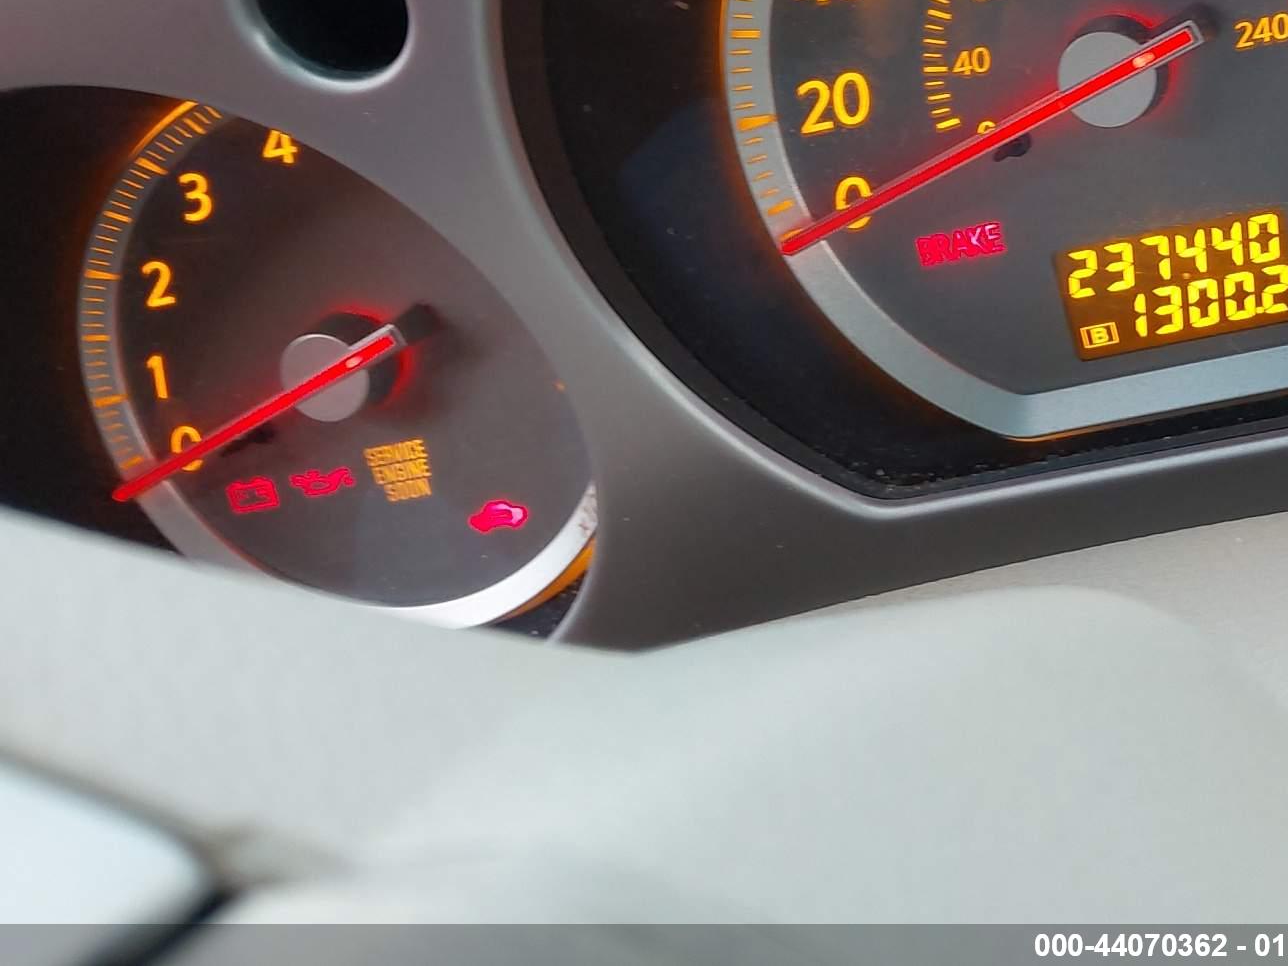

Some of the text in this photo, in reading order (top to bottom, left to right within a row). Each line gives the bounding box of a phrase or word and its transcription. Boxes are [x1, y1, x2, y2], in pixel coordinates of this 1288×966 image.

[953, 46, 991, 77] 40
[796, 71, 871, 135] 20
[262, 129, 299, 164] 4
[178, 172, 213, 222] 3
[835, 176, 875, 230] 0
[914, 222, 1006, 269] BRAKE
[1067, 212, 1283, 300] 237440
[142, 261, 176, 308] 2
[145, 354, 168, 400] 1
[169, 425, 205, 472] 0
[362, 439, 428, 467] SERVICE
[371, 458, 432, 487] ENGINE
